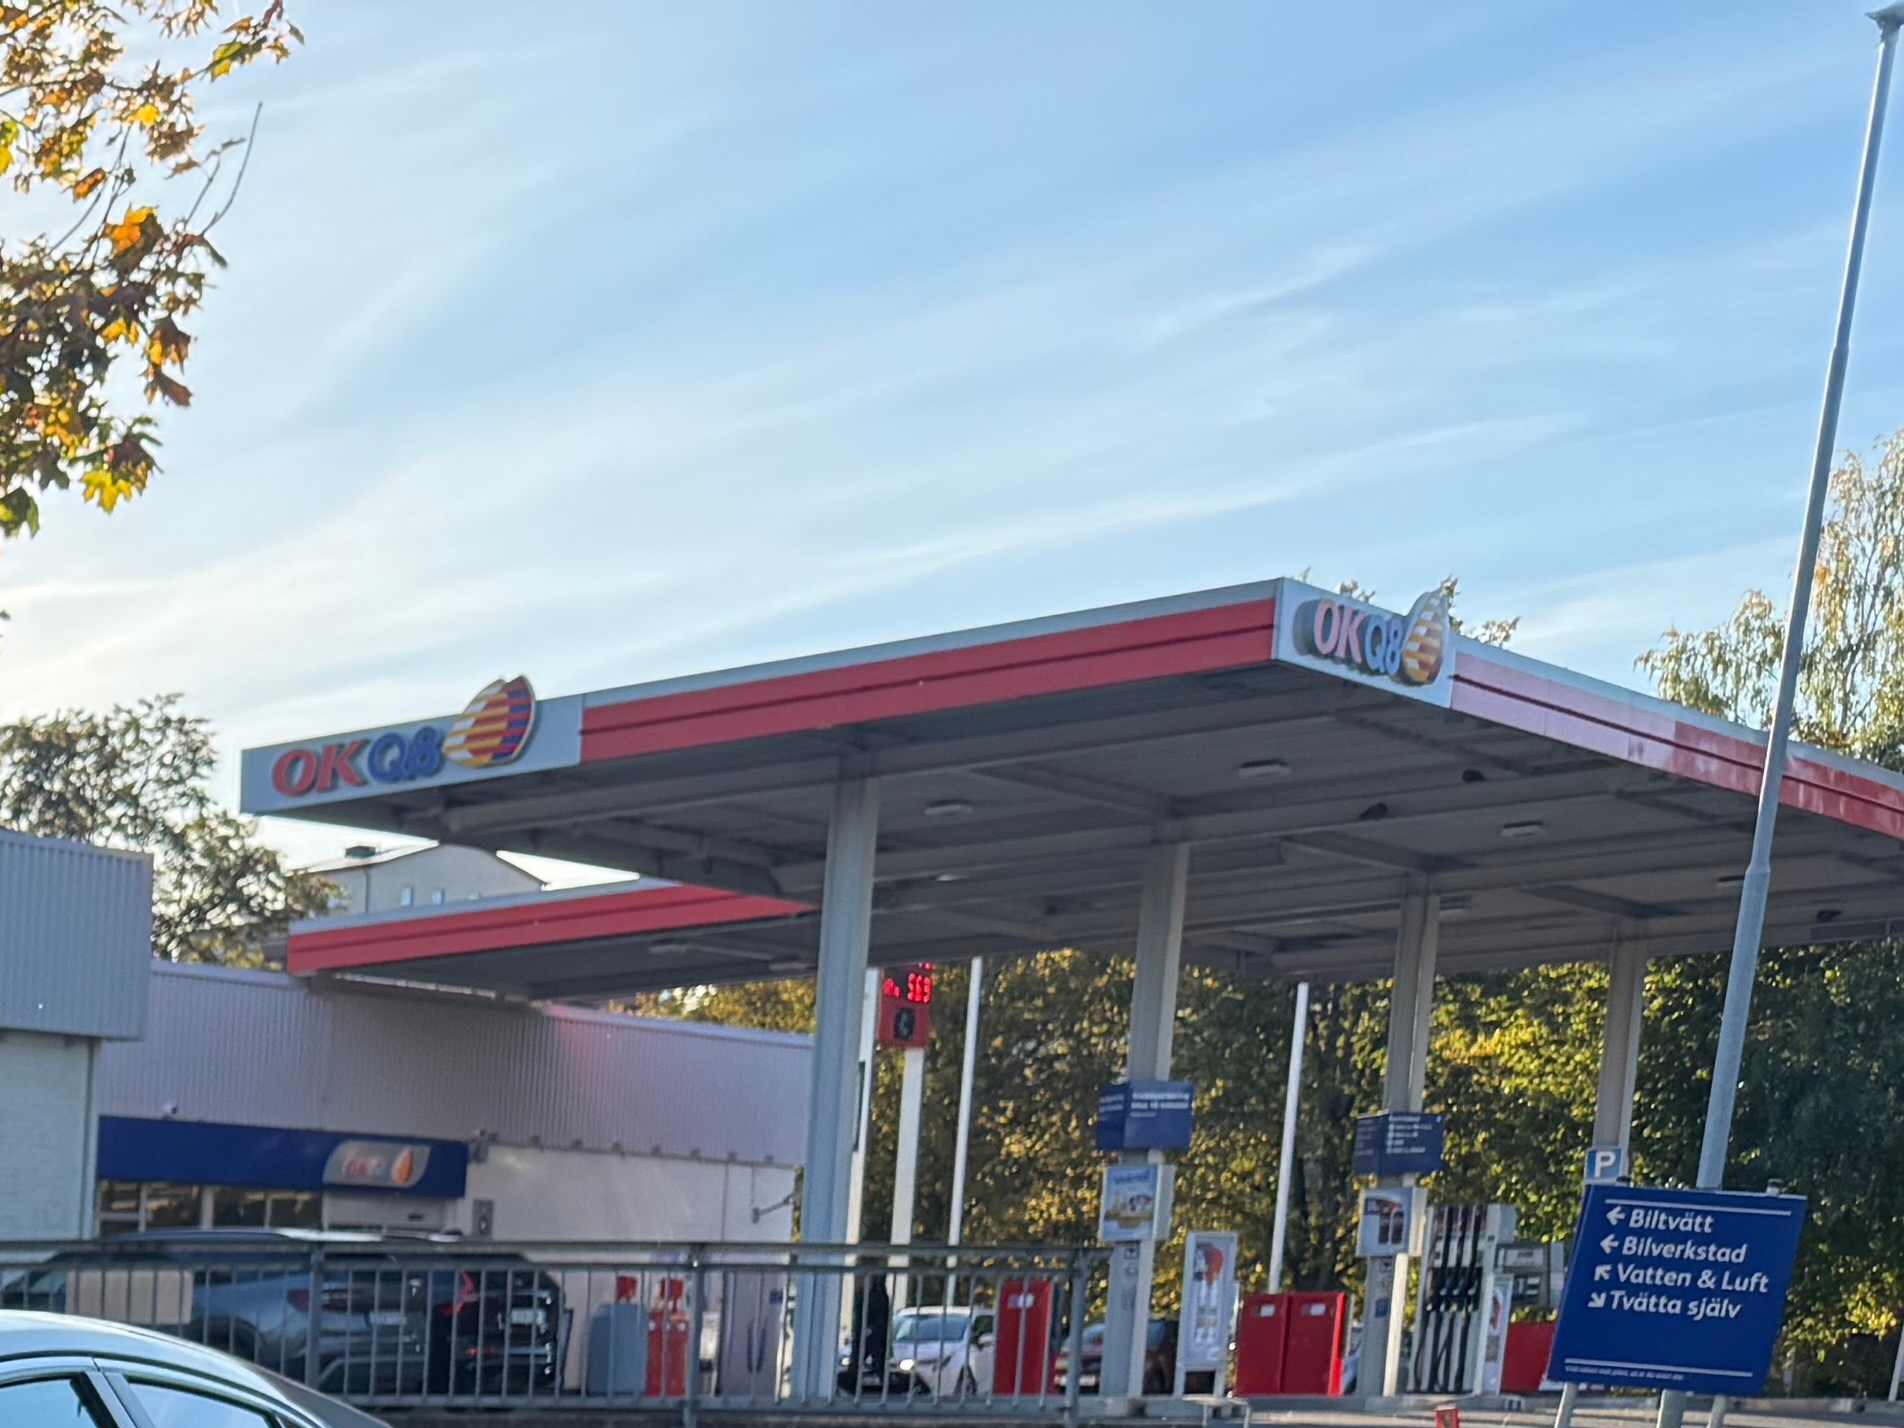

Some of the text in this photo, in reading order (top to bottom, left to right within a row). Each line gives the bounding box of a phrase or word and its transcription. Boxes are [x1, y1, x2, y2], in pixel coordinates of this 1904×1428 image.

[1594, 1152, 1616, 1178] P
[1629, 1208, 1715, 1234] Biltvätt
[1622, 1236, 1747, 1264] Bilverkstad
[1617, 1263, 1769, 1294] Vatten & Luft
[1610, 1290, 1742, 1322] Tvätta själv
